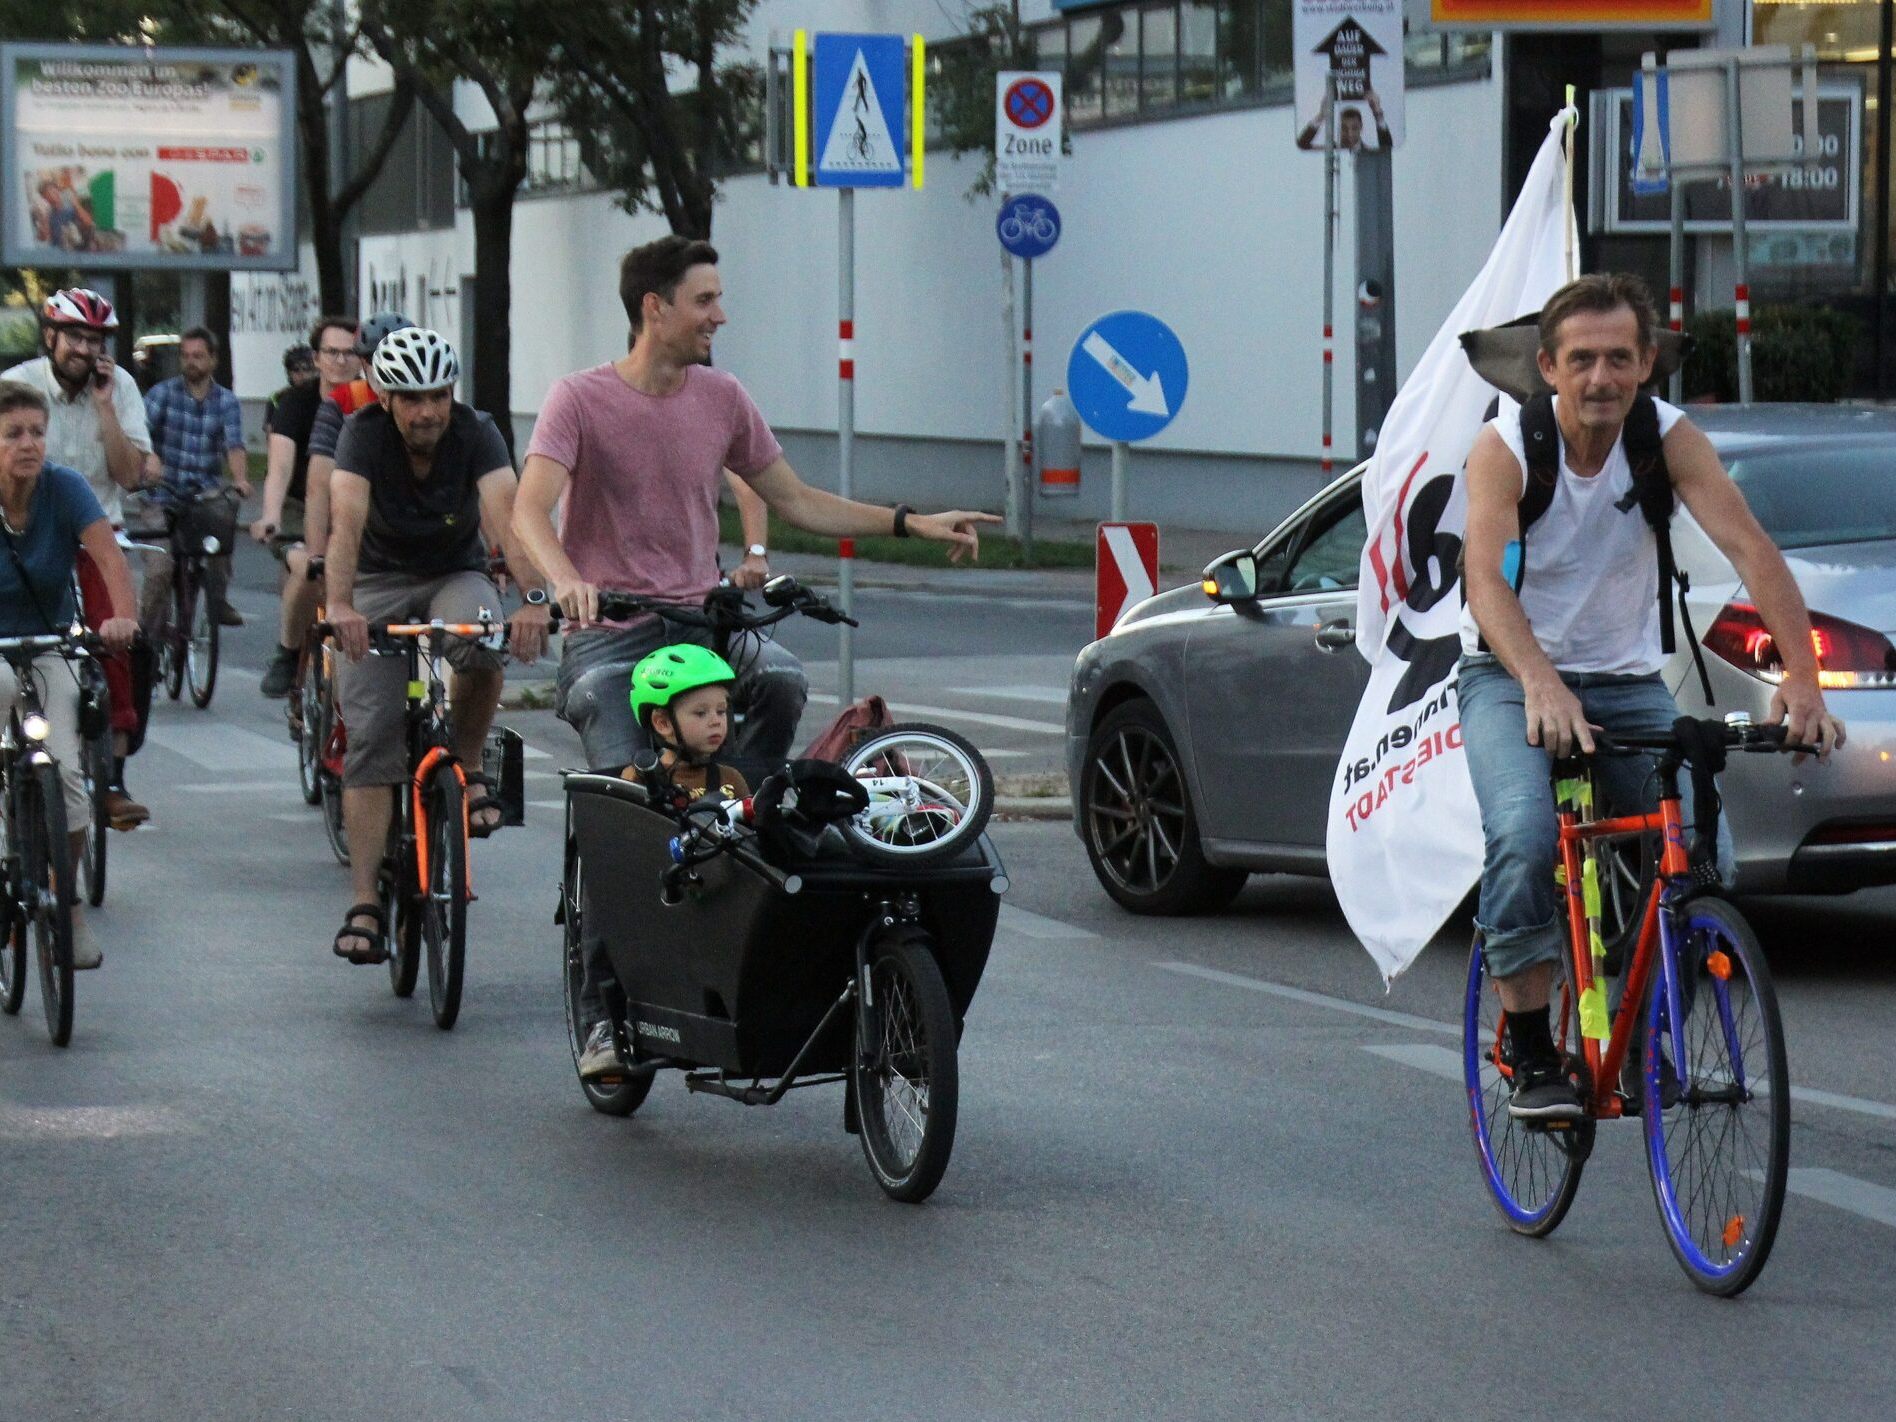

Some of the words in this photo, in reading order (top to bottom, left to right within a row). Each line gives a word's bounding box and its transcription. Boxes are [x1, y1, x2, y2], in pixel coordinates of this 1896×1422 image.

[40, 60, 149, 78] Willkommen
[31, 78, 92, 95] besten
[98, 80, 128, 95] Zoo
[132, 81, 209, 101] Europas!
[1004, 132, 1052, 155] Zone
